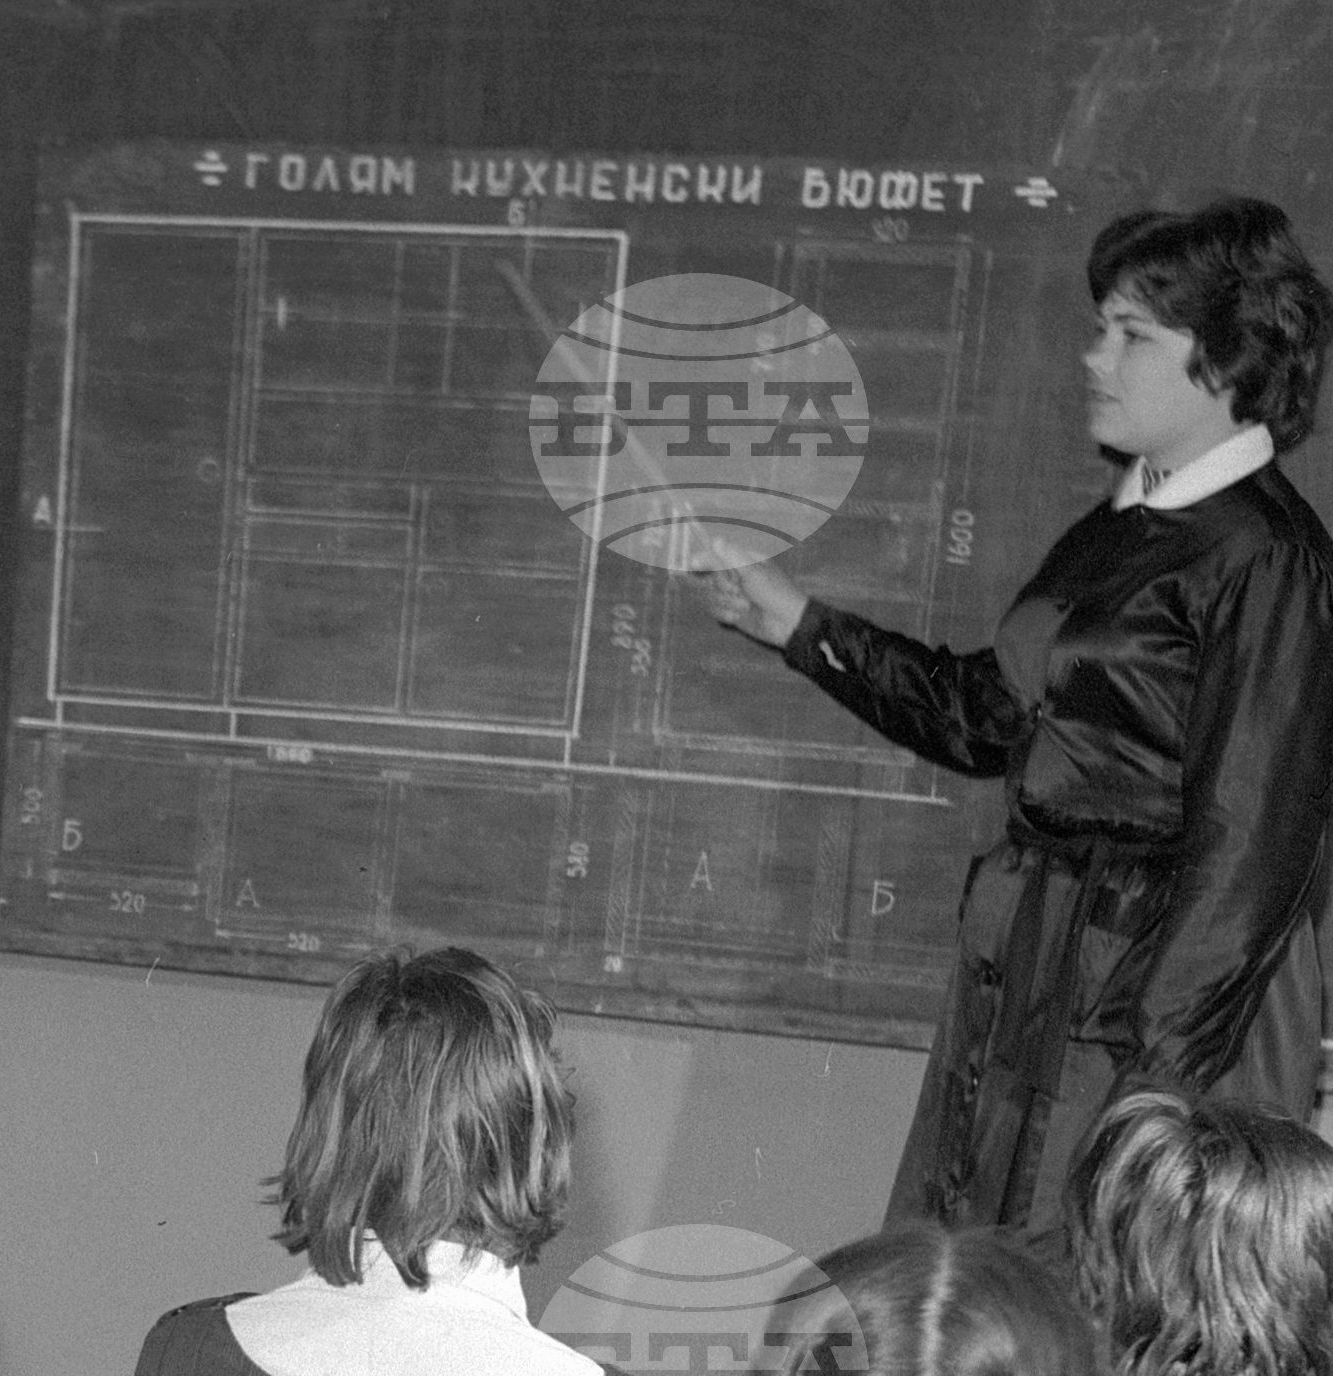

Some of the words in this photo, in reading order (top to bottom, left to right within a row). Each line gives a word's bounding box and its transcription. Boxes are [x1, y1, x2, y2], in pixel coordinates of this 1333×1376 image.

[244, 153, 414, 195] ГОЛЯМ
[801, 167, 985, 212] БЮФЕТ
[945, 509, 975, 565] 1600
[61, 819, 83, 852] Б
[690, 850, 713, 891] А
[235, 879, 261, 908] А
[871, 880, 897, 917] Б
